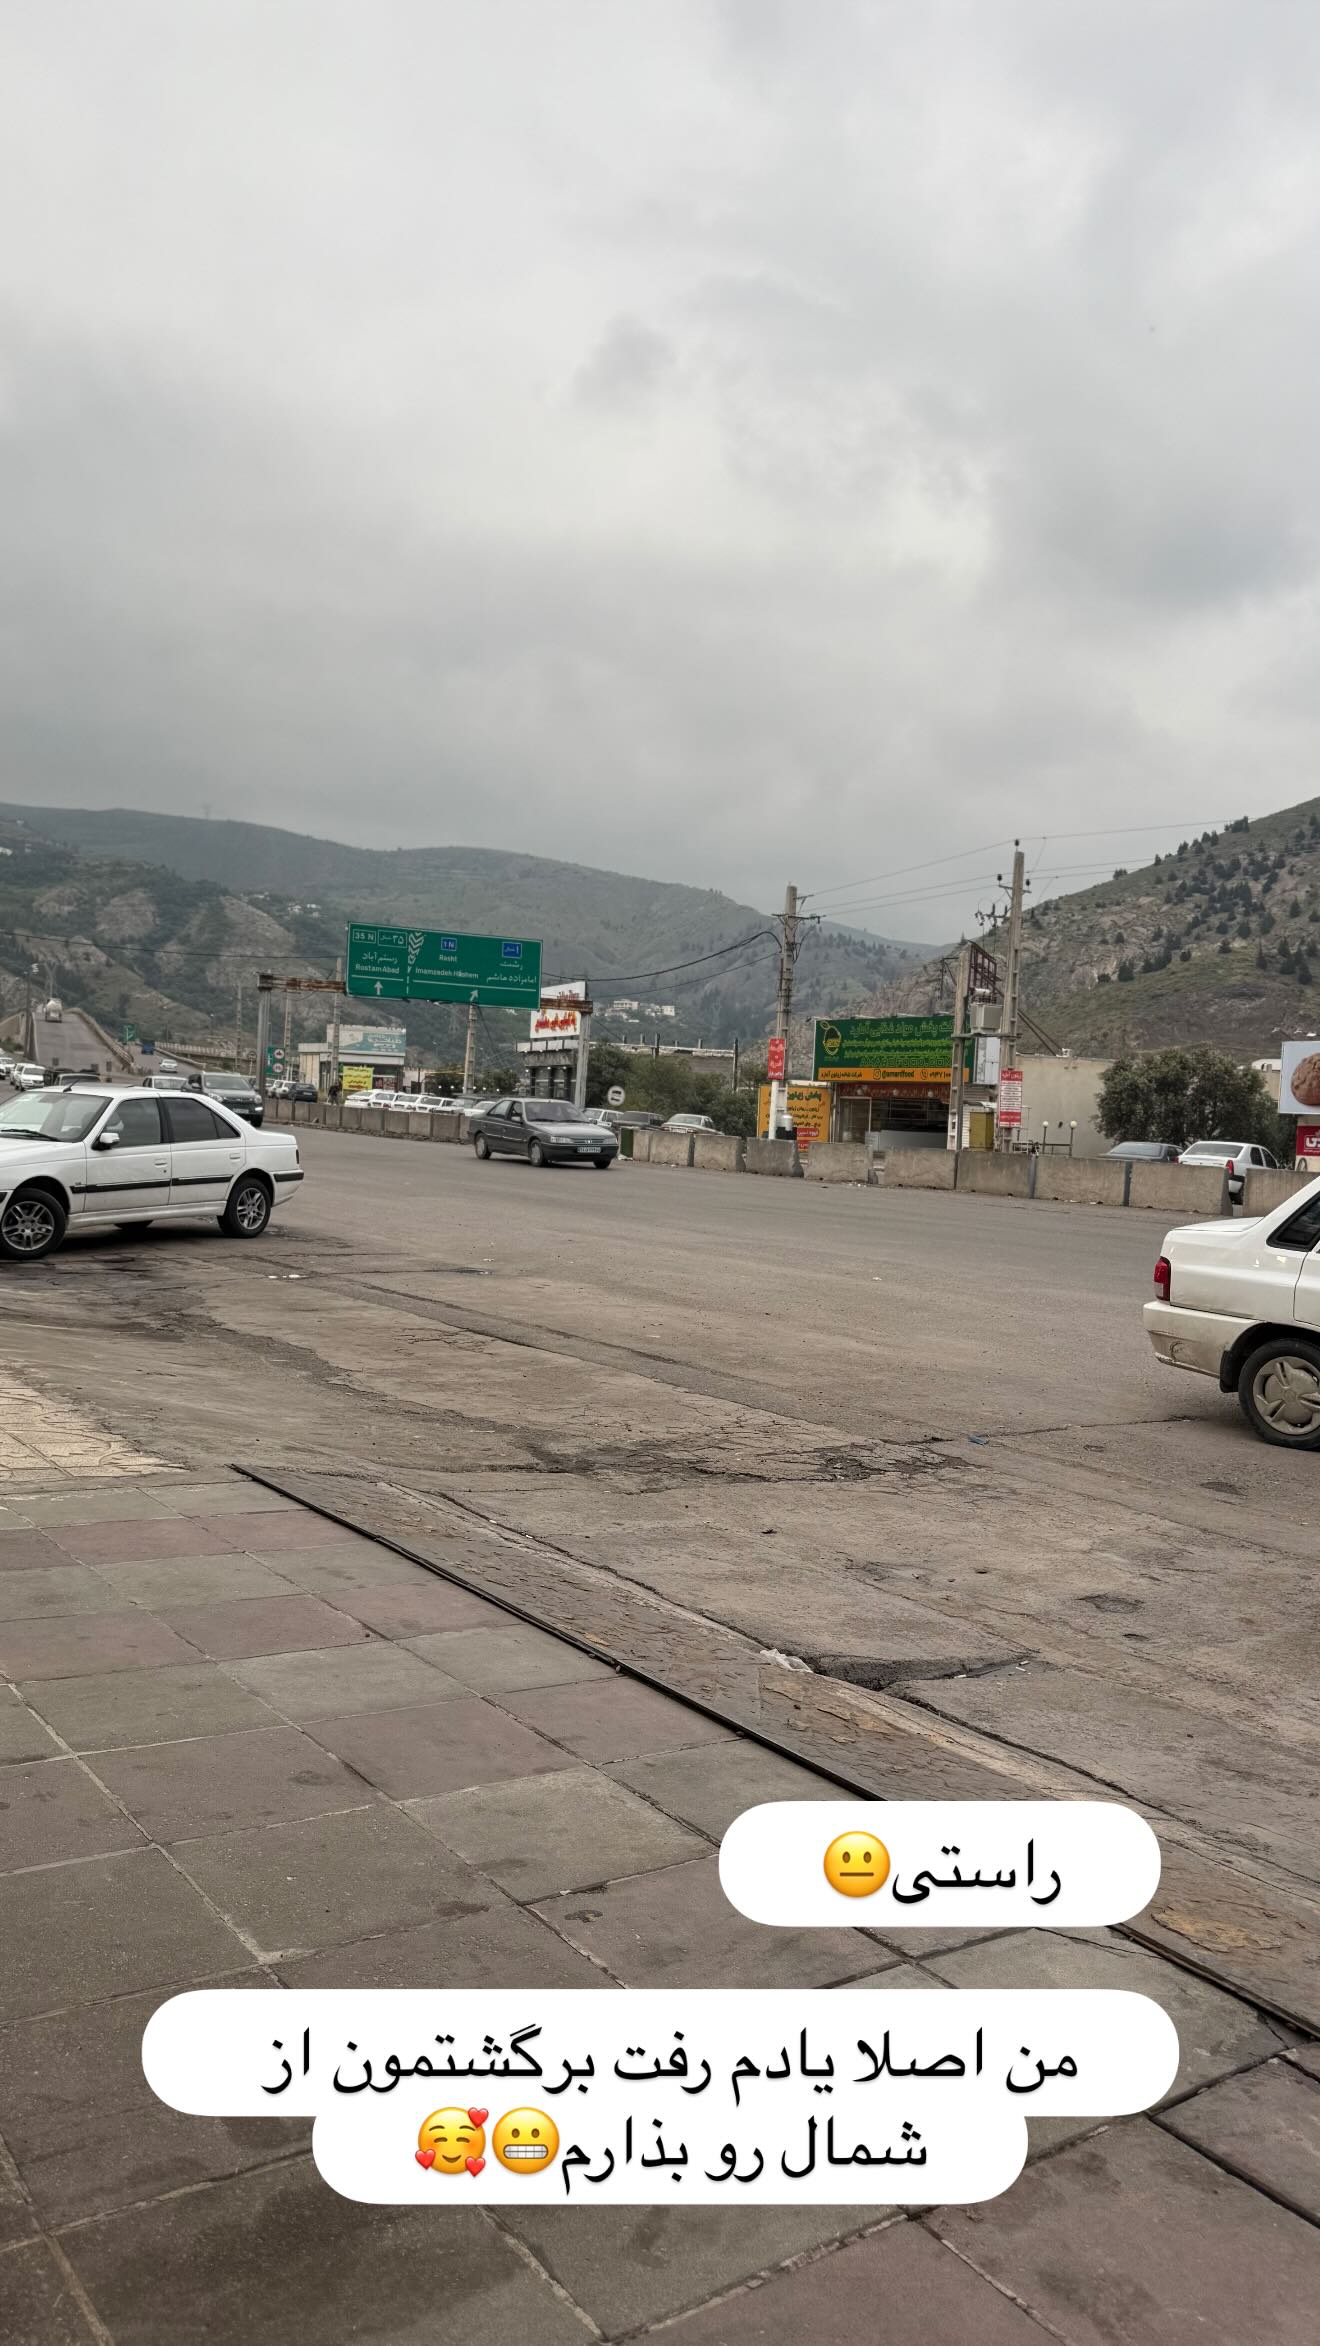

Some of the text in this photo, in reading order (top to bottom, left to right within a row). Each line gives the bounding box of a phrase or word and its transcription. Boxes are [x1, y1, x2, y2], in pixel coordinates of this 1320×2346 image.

[354, 931, 375, 941] 35 N
[448, 941, 454, 949] N
[361, 951, 398, 965] رستم آباد
[438, 954, 457, 962] Rasht
[498, 959, 523, 971] رشت
[415, 966, 451, 977] Imamzadeh
[486, 972, 508, 983] هاشم
